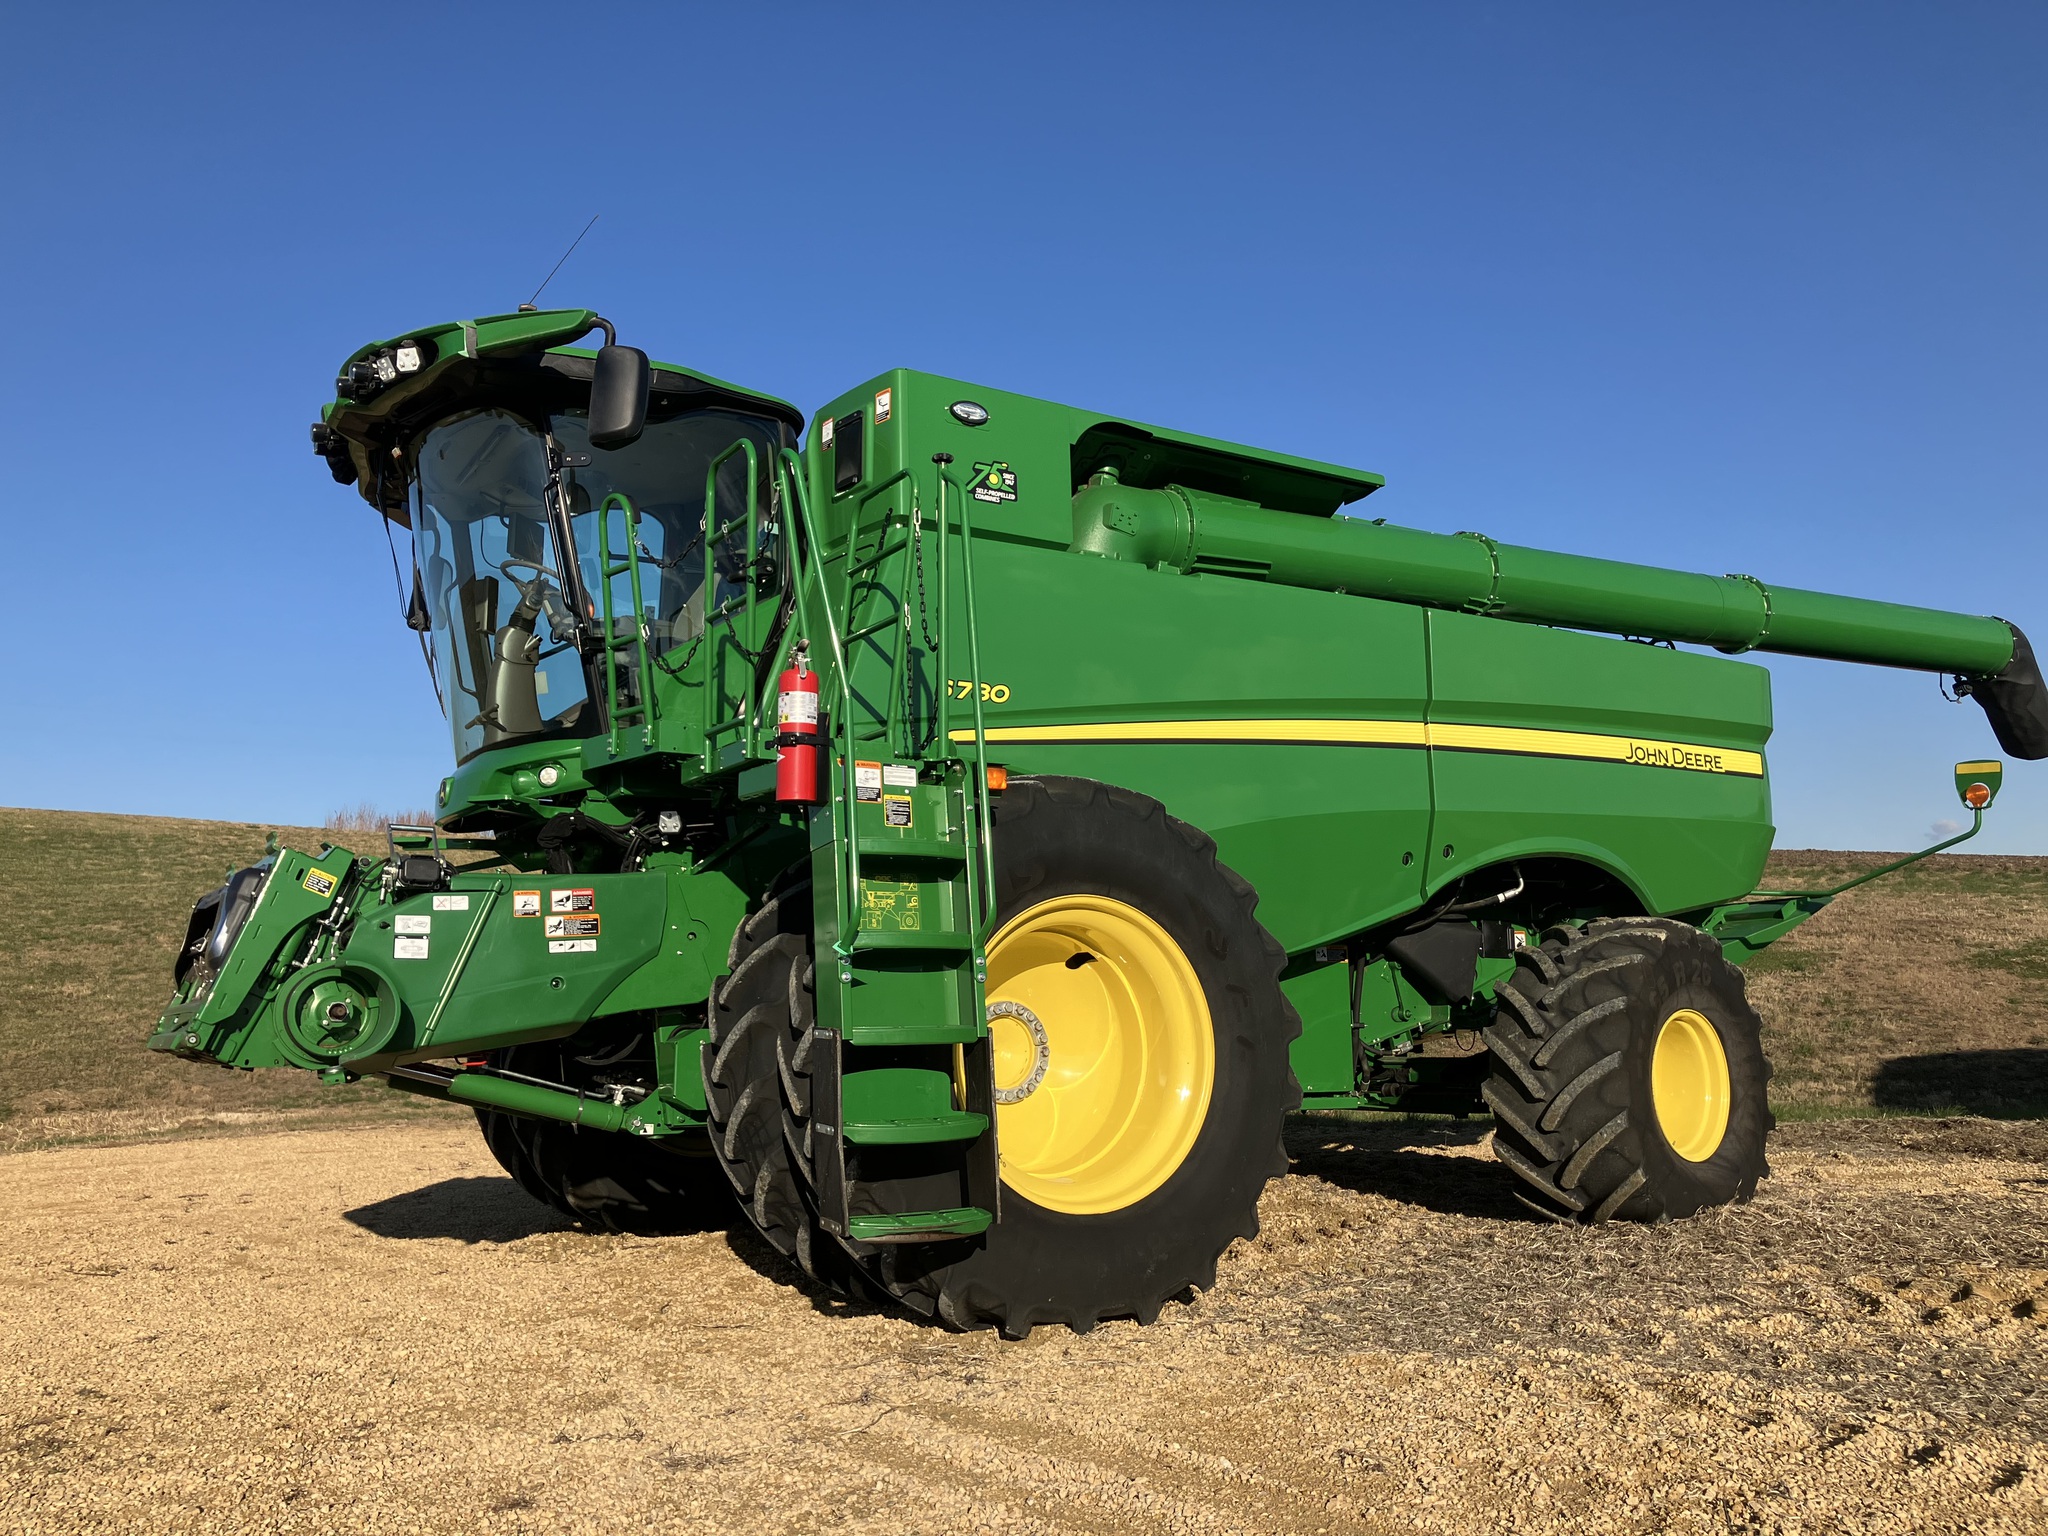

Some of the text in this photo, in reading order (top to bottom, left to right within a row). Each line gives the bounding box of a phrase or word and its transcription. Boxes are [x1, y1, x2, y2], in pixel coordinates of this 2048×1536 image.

[966, 463, 1007, 491] 75
[975, 487, 1016, 500] SELF-PROPELLED
[1626, 743, 1723, 769] JOHN DEERE
